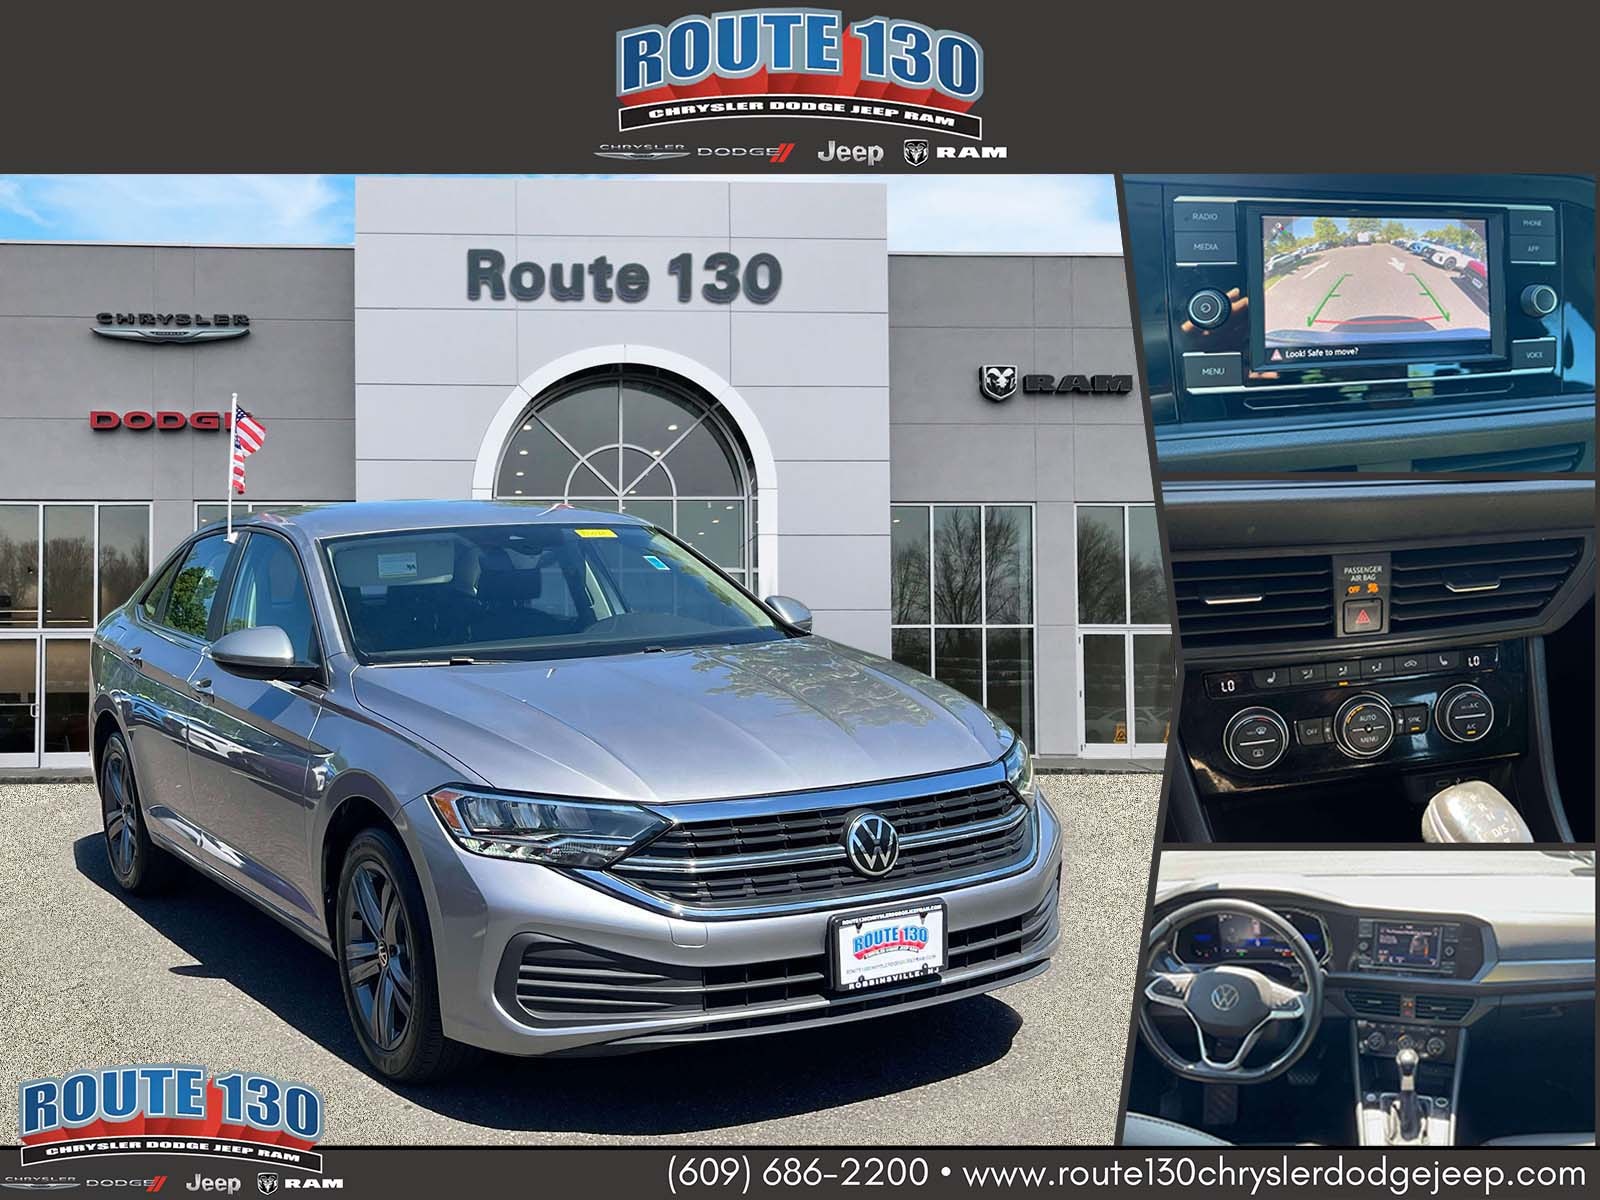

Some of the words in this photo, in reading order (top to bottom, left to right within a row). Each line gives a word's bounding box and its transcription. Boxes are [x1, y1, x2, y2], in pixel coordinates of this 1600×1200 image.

[1192, 212, 1218, 221] RADIO
[1193, 243, 1219, 251] MEDIA
[467, 248, 650, 303] Route
[668, 252, 782, 304] 130
[96, 312, 250, 327] CHRYSLER
[1307, 349, 1324, 357] Safe
[1325, 349, 1334, 357] to
[1334, 347, 1359, 356] move?
[1201, 367, 1226, 376] MENU
[1023, 374, 1133, 394] RAM
[1344, 565, 1383, 575] PASSENGER
[1350, 574, 1362, 582] AIR
[1363, 573, 1377, 581] BAG
[1359, 713, 1377, 722] AUTO
[1360, 735, 1379, 744] MENU
[853, 926, 899, 954] ROUTE
[903, 925, 929, 943] 130
